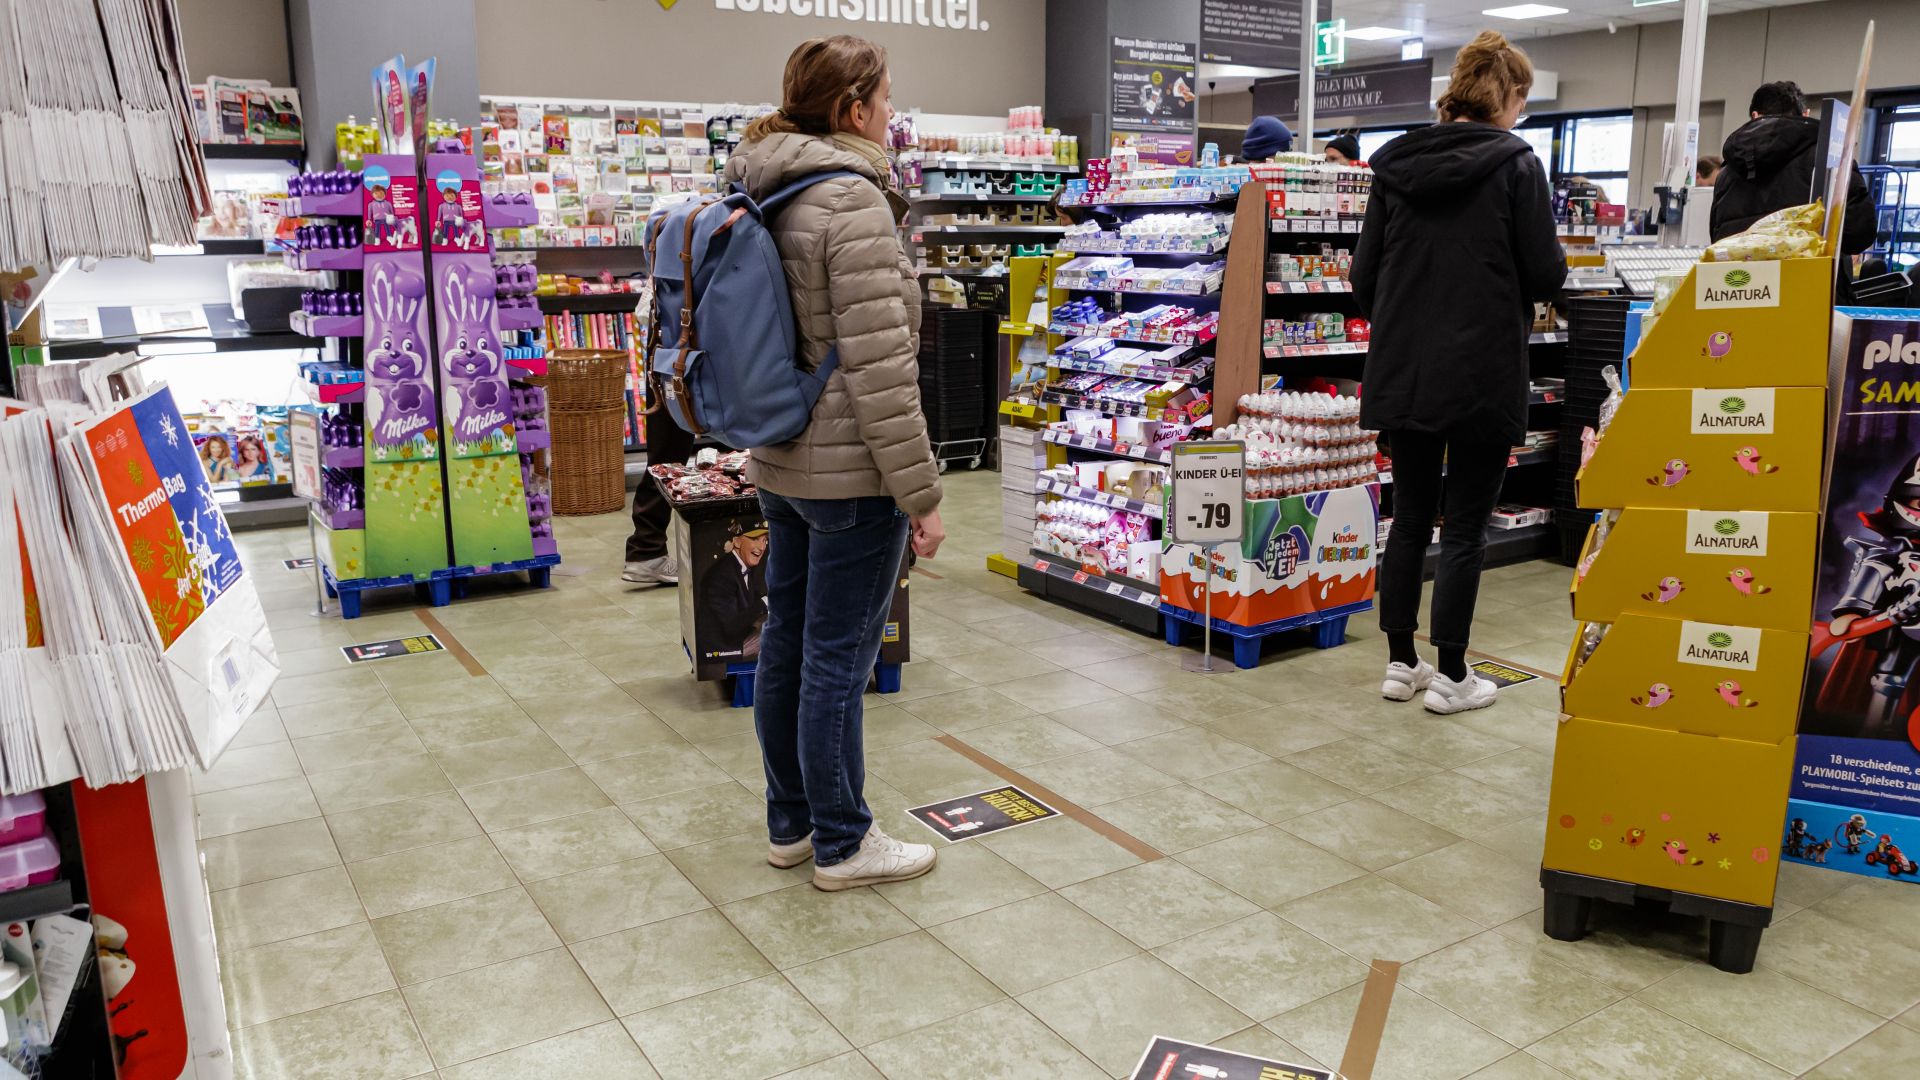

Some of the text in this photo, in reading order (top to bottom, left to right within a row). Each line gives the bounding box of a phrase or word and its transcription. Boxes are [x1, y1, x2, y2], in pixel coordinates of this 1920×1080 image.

[715, 0, 990, 31] nsmittel.
[1315, 78, 1341, 93] IELEN
[1704, 285, 1771, 302] ALNATURA
[381, 413, 430, 439] Milka
[461, 410, 507, 435] Milka
[1700, 412, 1765, 427] ALNATURA
[1153, 429, 1183, 443] bueno
[1175, 467, 1241, 479] KINDER Ü-EI
[117, 473, 186, 527] Thermo Bag
[1187, 502, 1231, 529] -.79
[1268, 537, 1296, 551] Jetzt
[1694, 534, 1758, 549] ALNATURA
[1265, 548, 1299, 561] in jedem
[1277, 558, 1296, 576] Ei!
[1687, 644, 1749, 663] ALNATURA
[1830, 754, 1842, 765] 18
[1844, 758, 1912, 775] verschiedene,
[1801, 765, 1904, 789] PLAYMOBIL-Spielsets
[979, 792, 1036, 822] HALTEN!
